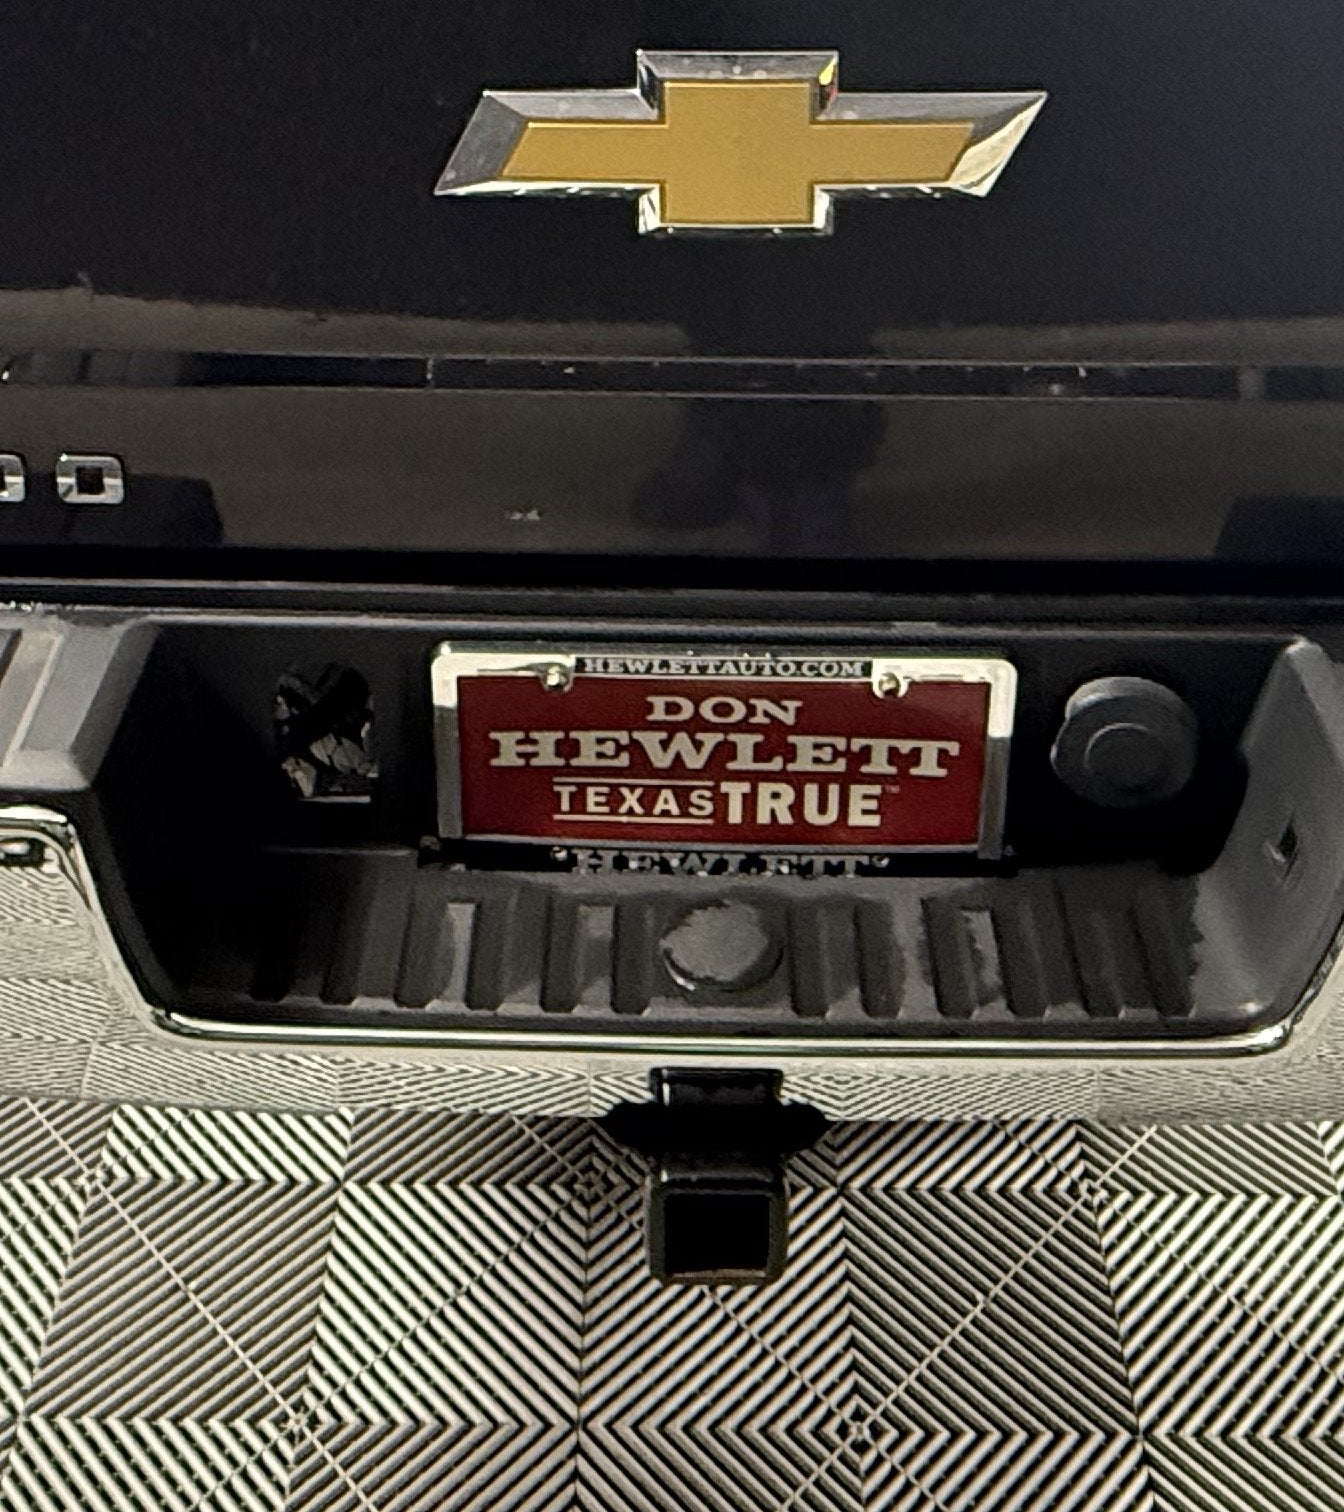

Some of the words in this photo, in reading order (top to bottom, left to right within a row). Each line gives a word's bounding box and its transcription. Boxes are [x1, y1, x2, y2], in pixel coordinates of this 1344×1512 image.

[583, 658, 864, 677] HEWLETTAUTO.COM
[645, 695, 804, 726] DON
[489, 730, 960, 778] HEWLETT
